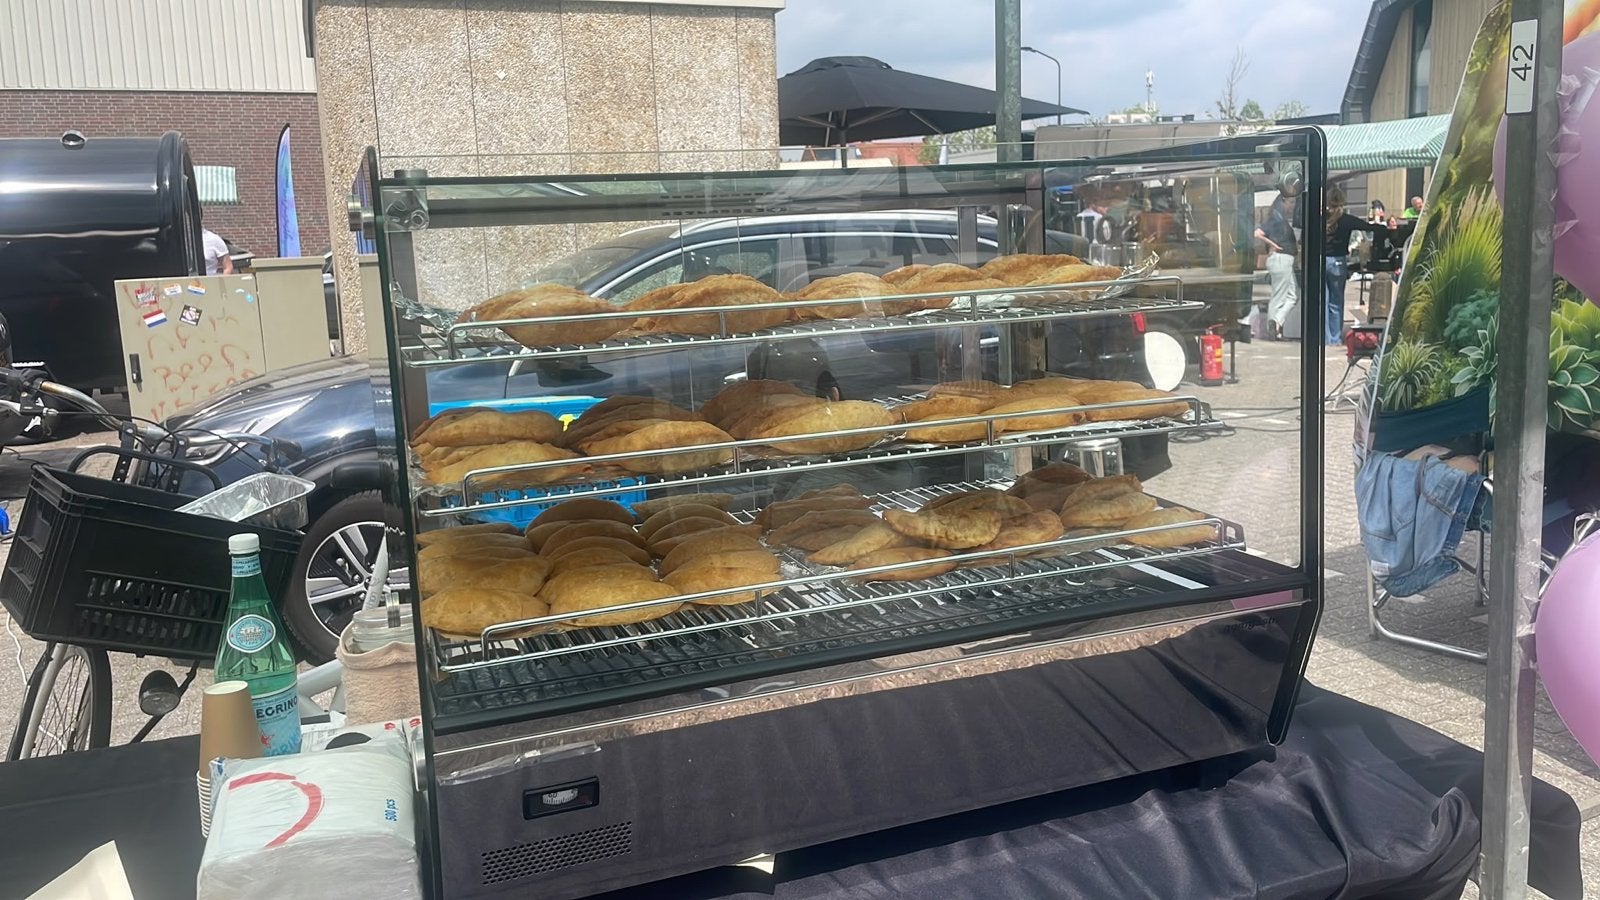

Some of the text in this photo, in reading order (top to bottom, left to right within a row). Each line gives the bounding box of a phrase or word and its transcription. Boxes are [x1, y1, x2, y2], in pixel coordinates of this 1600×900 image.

[1511, 43, 1534, 82] 42
[255, 695, 298, 719] EGRINO
[385, 799, 398, 821] 500 pcs
